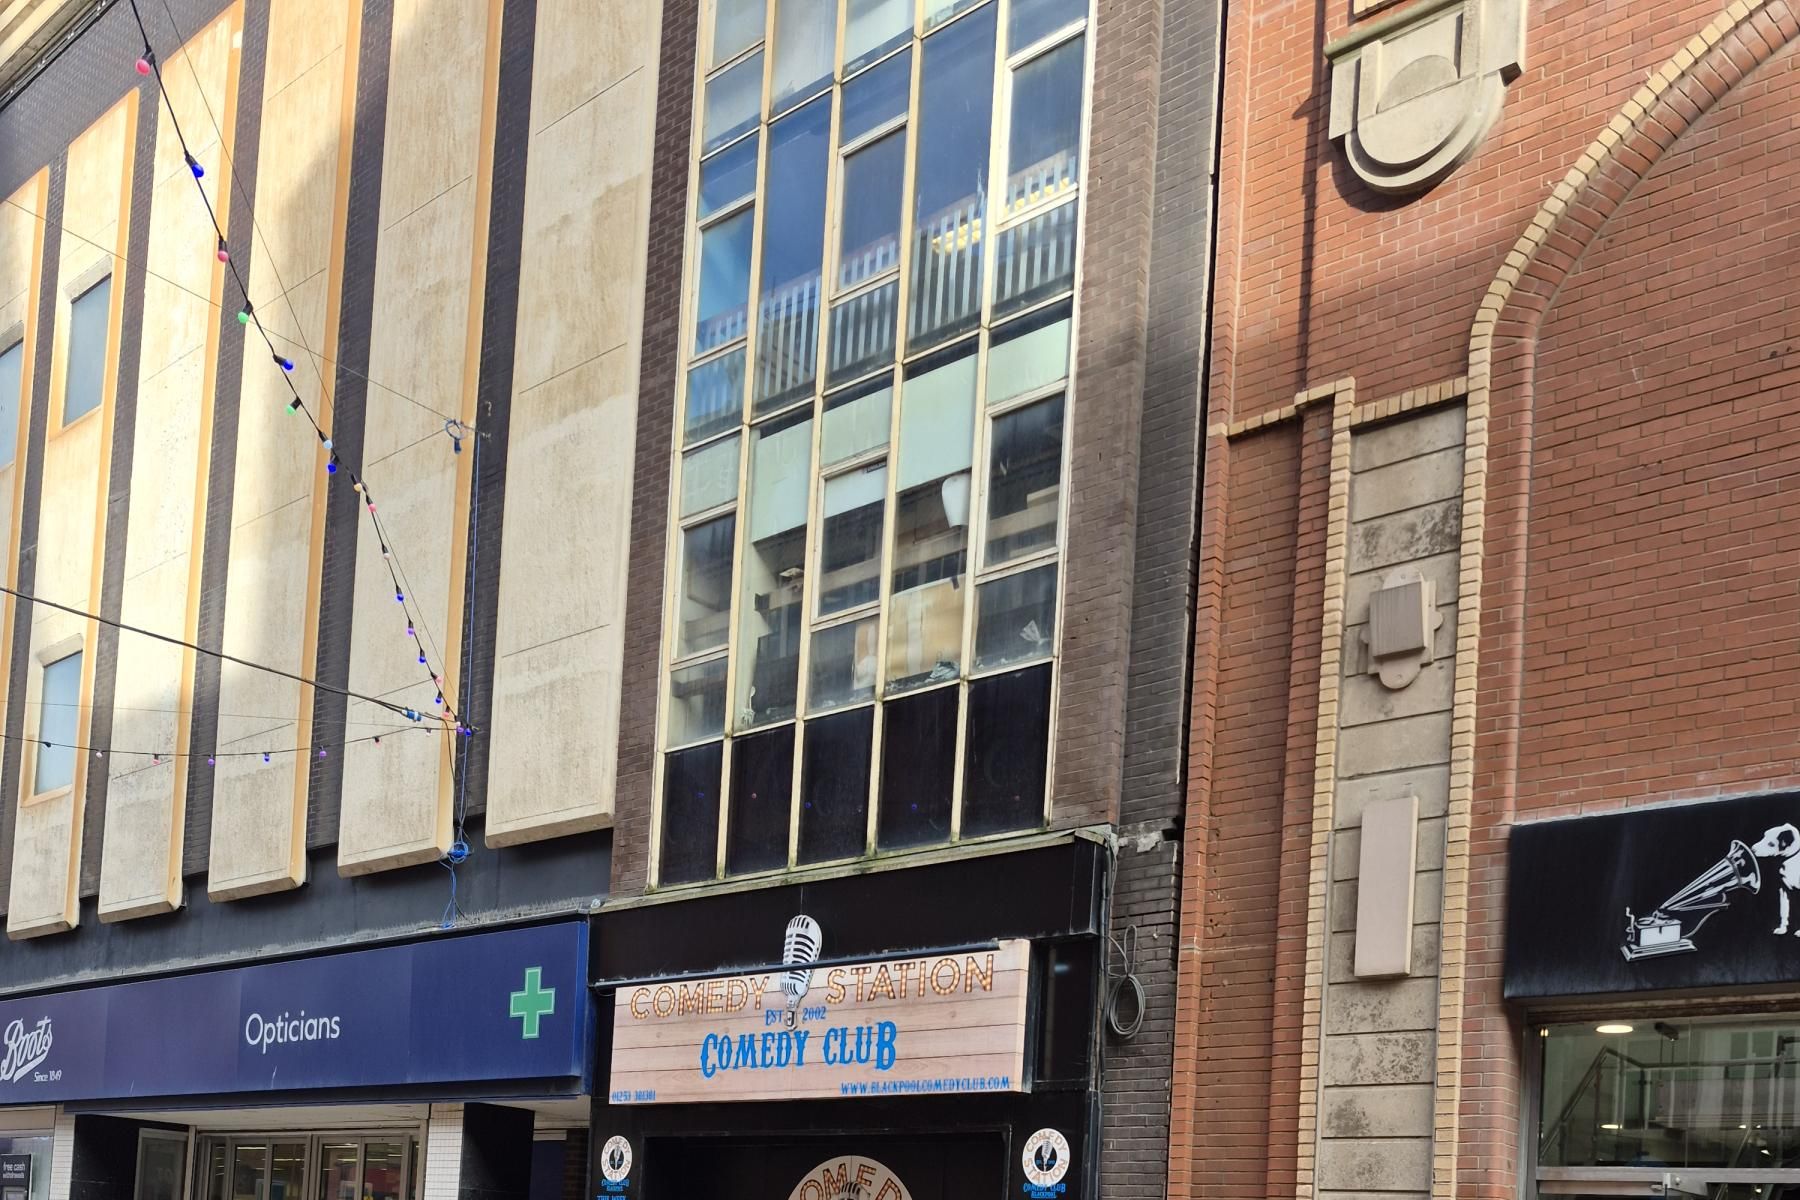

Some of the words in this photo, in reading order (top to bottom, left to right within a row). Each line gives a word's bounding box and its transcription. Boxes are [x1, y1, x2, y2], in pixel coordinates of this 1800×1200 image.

[630, 976, 770, 1020] COMEDY
[825, 954, 994, 1004] STATION
[245, 1010, 341, 1054] Opticians
[802, 1006, 826, 1021] 2002
[0, 1016, 53, 1083] Boots
[700, 1030, 810, 1078] COMEDY
[823, 1021, 897, 1071] CLUB
[1025, 1130, 1067, 1152] COMEDY
[1024, 1157, 1068, 1183] STATION
